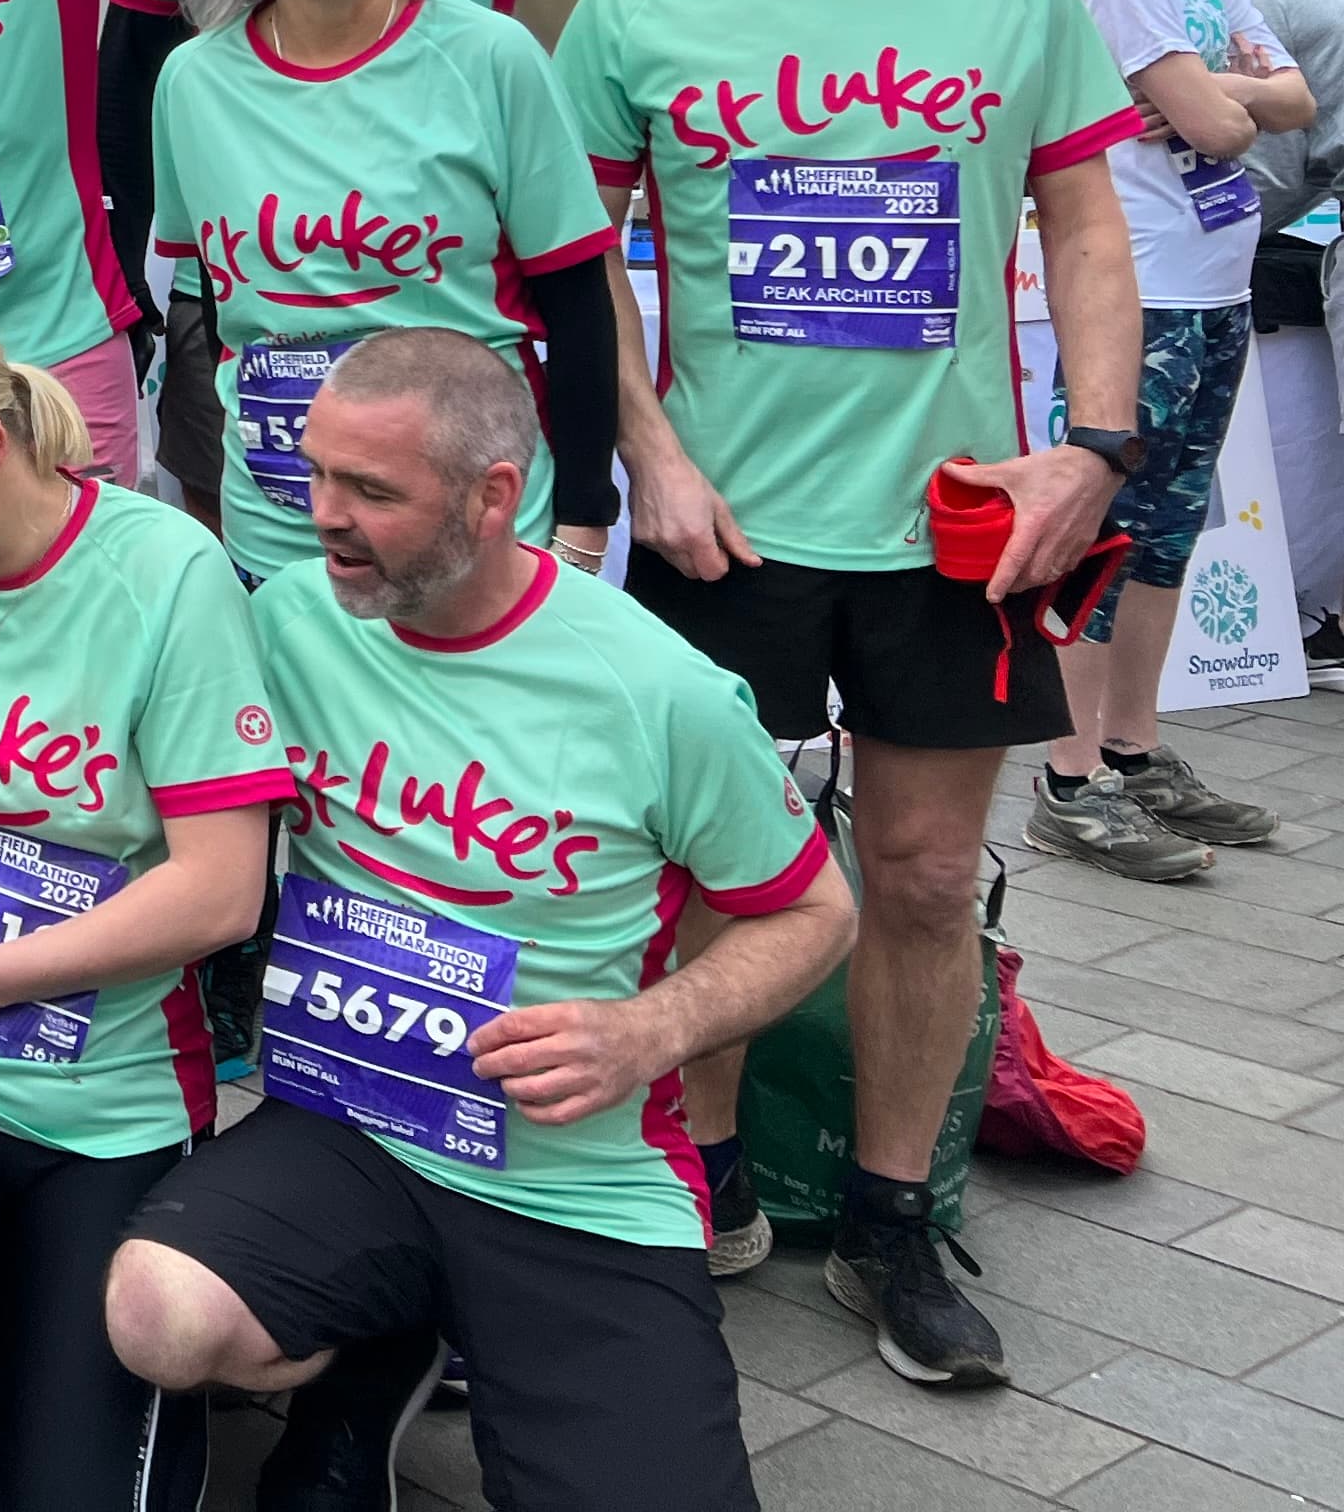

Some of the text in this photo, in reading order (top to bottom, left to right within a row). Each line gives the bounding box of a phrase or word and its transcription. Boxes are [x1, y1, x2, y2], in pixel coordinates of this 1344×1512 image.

[668, 46, 1002, 169] St Luke's
[795, 169, 875, 182] SHEFFIELD
[796, 182, 938, 196] HALF MARATHON
[884, 198, 939, 215] 2023
[202, 189, 463, 303] St Luke's
[768, 233, 929, 282] 2107
[762, 286, 934, 304] PEAK ARCHITECTS
[762, 325, 785, 337] FOR
[786, 327, 808, 338] ALL
[270, 352, 328, 366] SHEFFIELD
[271, 365, 301, 378] HALF
[1188, 648, 1280, 676] Snowdrop
[1209, 672, 1265, 690] PROJECT
[354, 740, 600, 896] Luke's
[3, 850, 98, 893] MARATHON
[39, 881, 95, 912] 2023
[348, 899, 424, 936] SHEFFIELD
[347, 917, 485, 972] HALF MARATHON
[427, 960, 485, 994] 2023
[305, 970, 468, 1057] 5679
[296, 1060, 319, 1078] FOR
[320, 1070, 340, 1086] ALL
[443, 1133, 499, 1161] 5679
